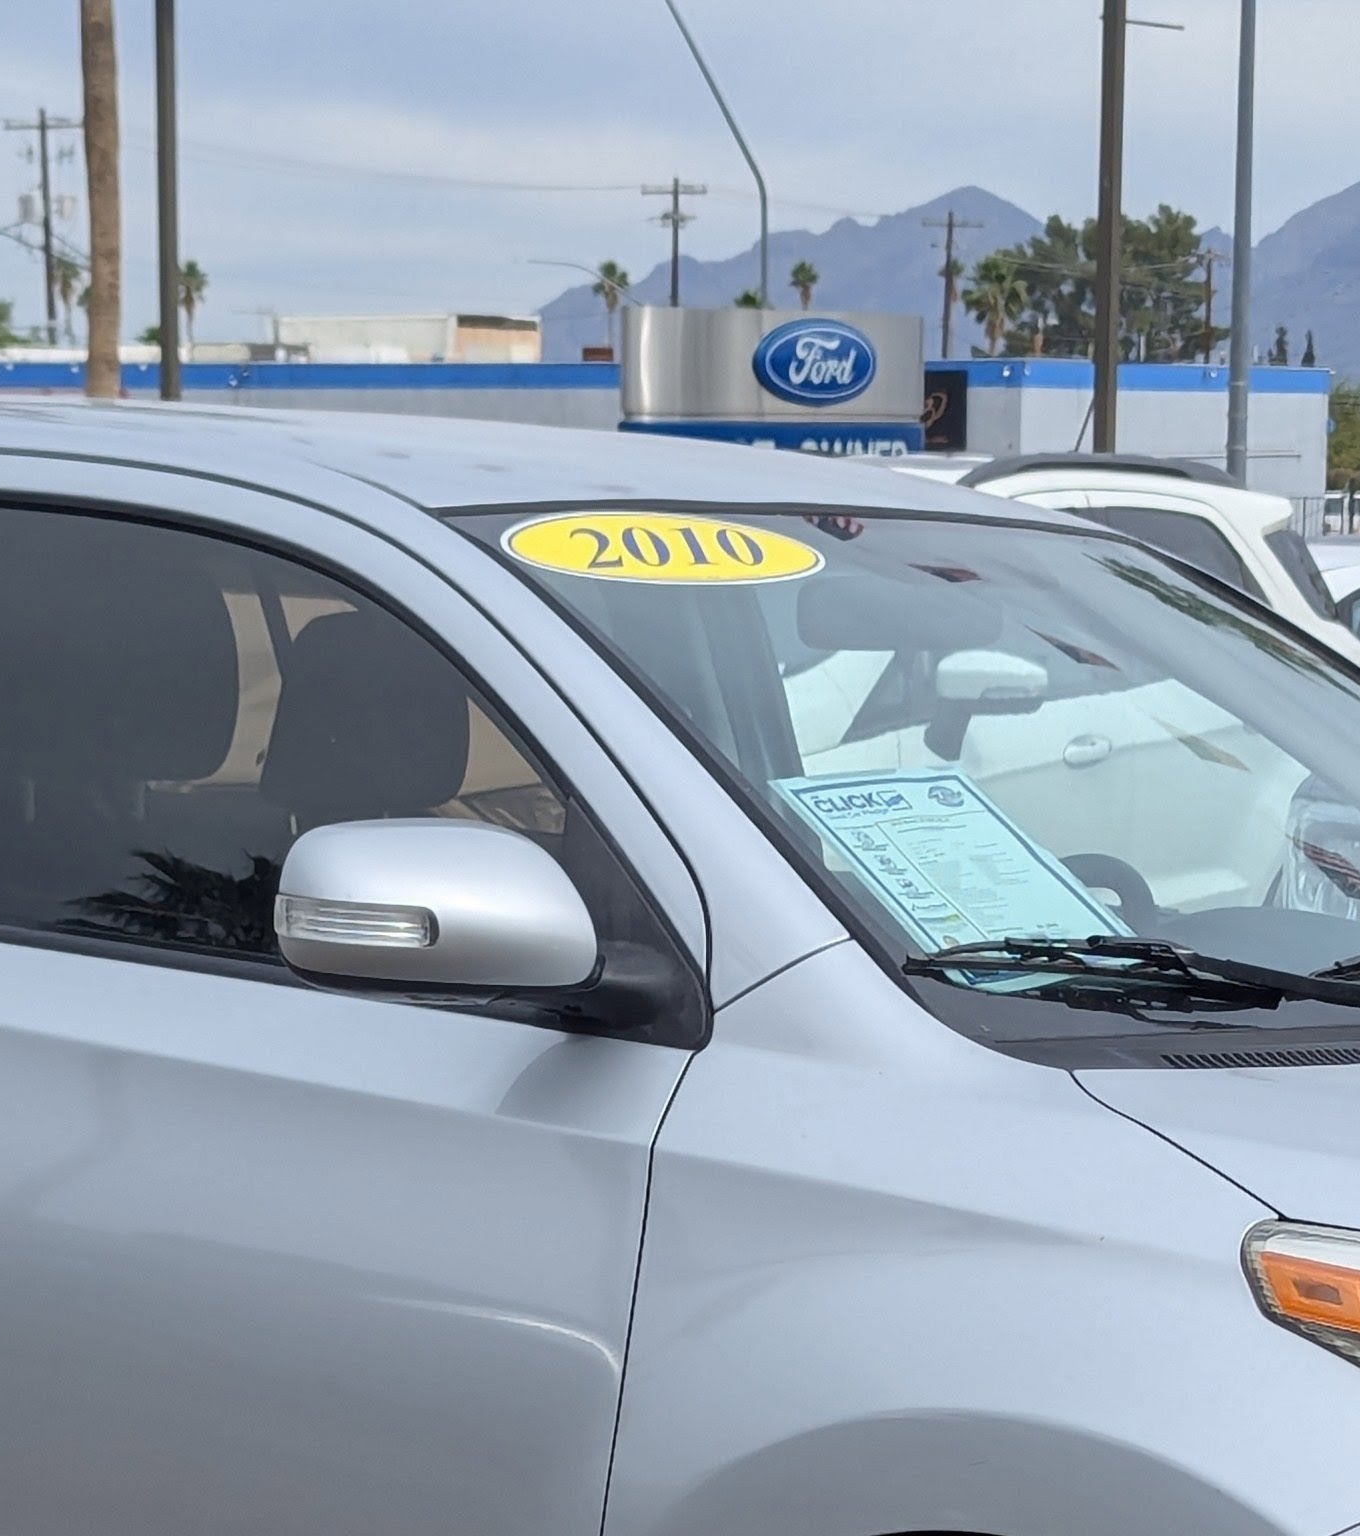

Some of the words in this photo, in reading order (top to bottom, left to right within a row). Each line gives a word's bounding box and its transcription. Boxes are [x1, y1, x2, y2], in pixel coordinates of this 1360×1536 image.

[789, 335, 858, 386] Ford
[568, 525, 764, 570] 2010
[814, 791, 883, 813] CLICK
